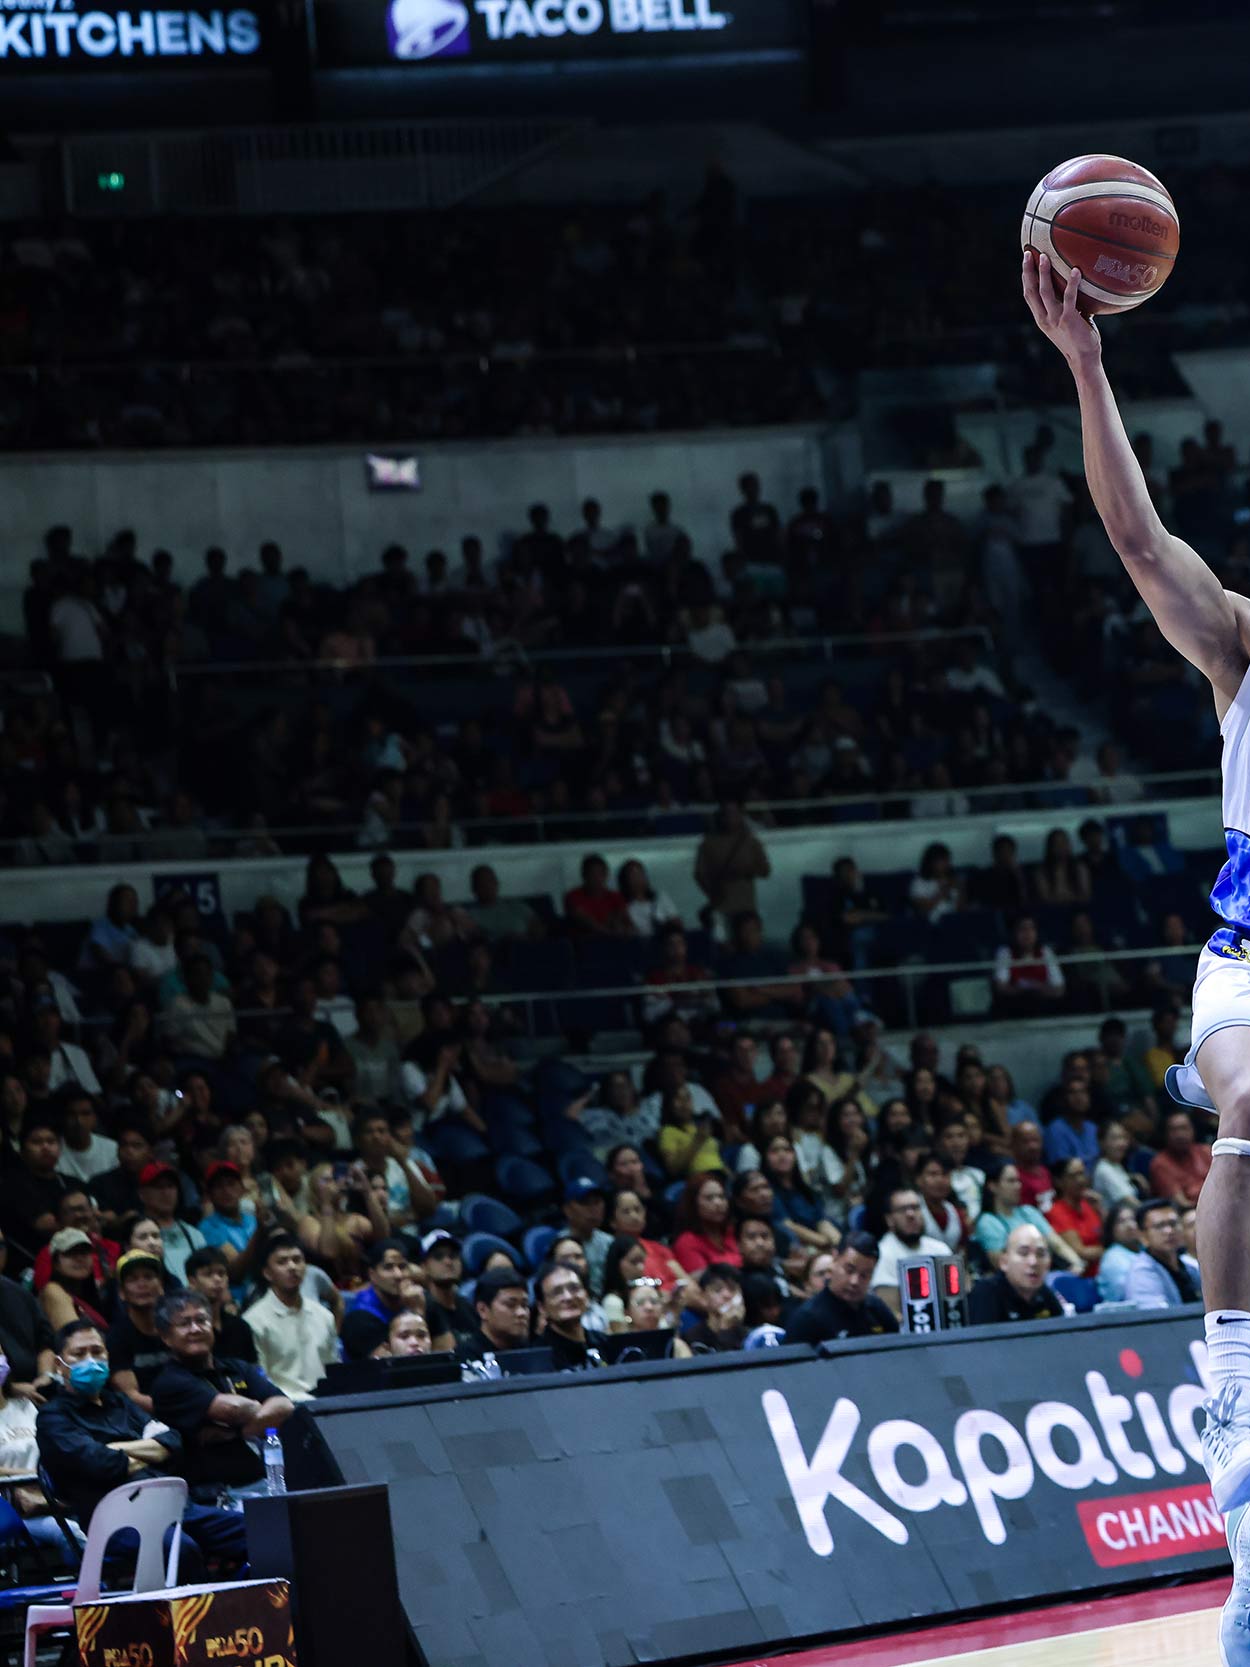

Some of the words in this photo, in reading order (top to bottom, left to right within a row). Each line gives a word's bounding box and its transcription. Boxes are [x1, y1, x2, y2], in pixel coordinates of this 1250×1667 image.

[0, 10, 260, 57] KITCHENS
[475, 0, 603, 40] TACO
[609, 0, 728, 33] BELL
[1108, 211, 1168, 241] molten
[1096, 1496, 1226, 1551] CHANN
